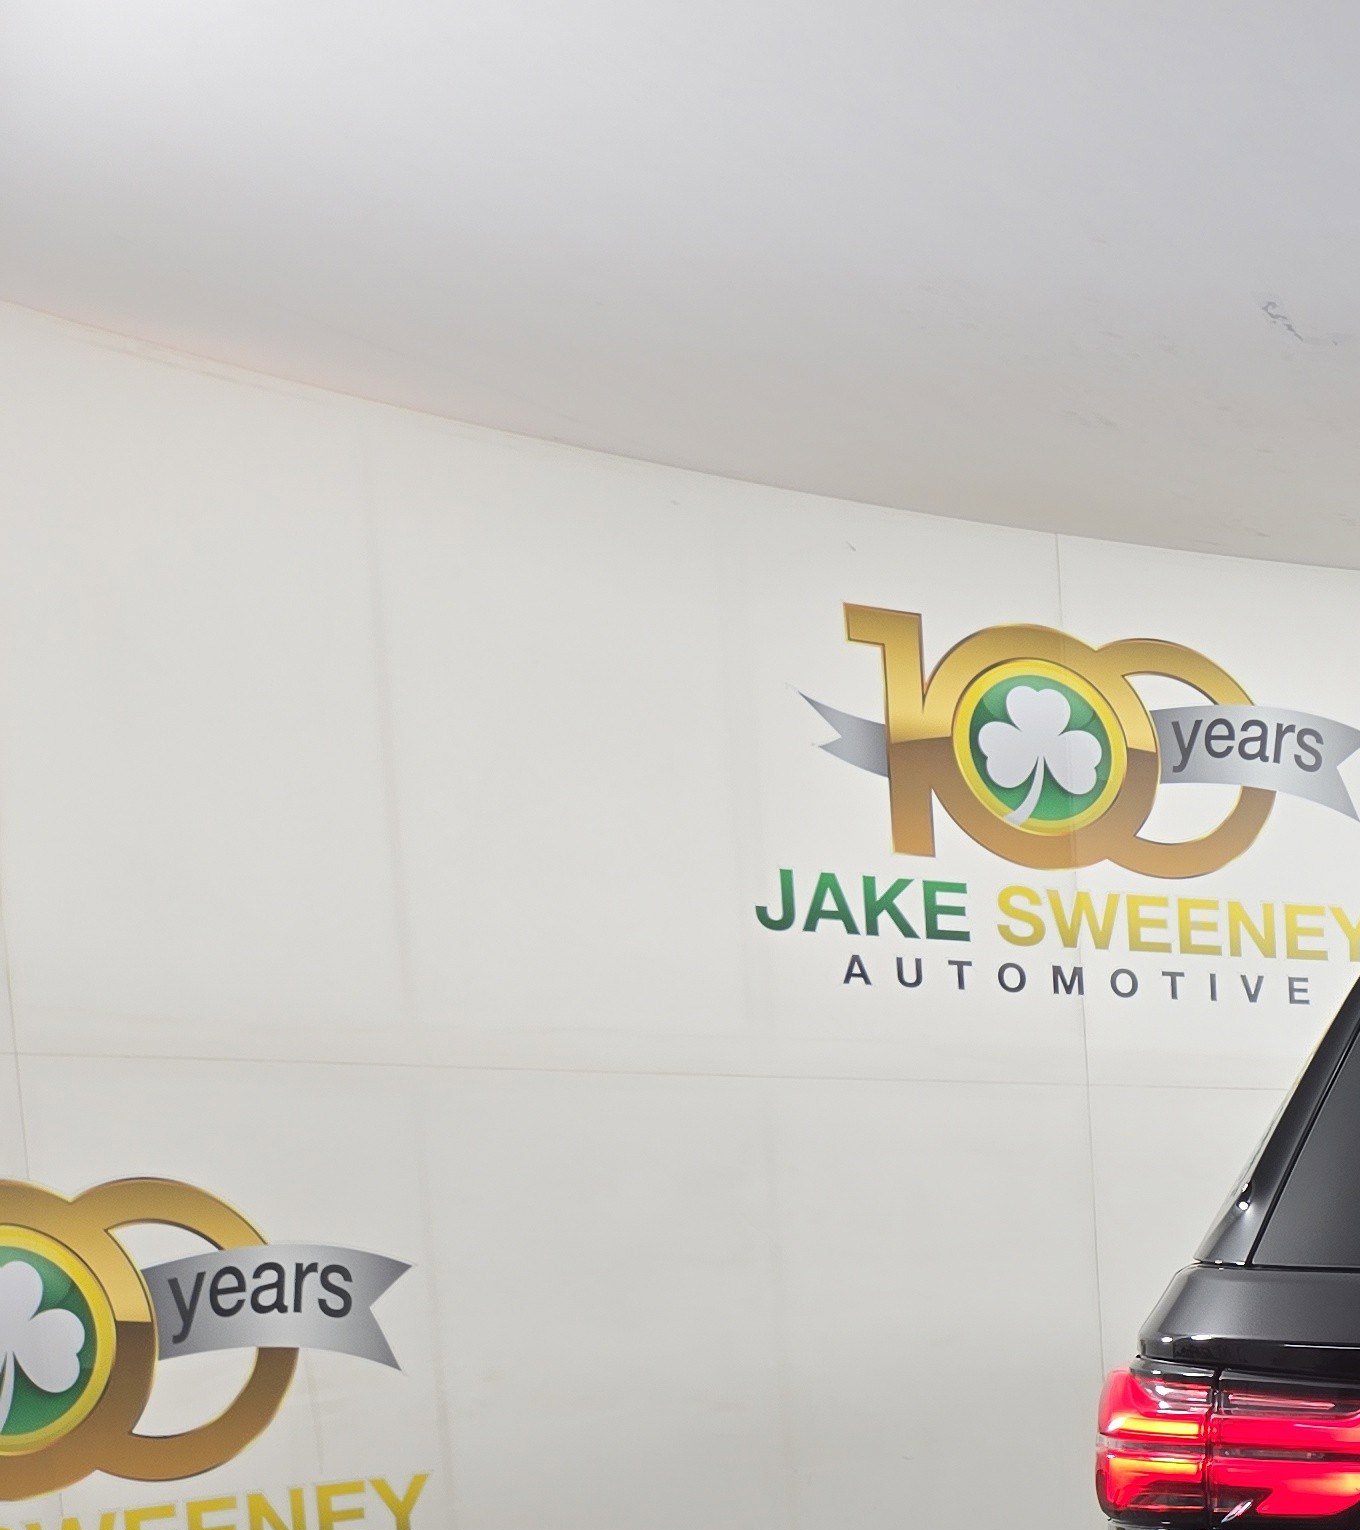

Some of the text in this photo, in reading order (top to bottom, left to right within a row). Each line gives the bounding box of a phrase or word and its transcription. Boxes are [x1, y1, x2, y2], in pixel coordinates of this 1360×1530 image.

[842, 602, 1324, 879] 100 years
[755, 868, 971, 943] JAKE
[843, 953, 1311, 1005] AUTOMOTIVE
[167, 1261, 353, 1344] years
